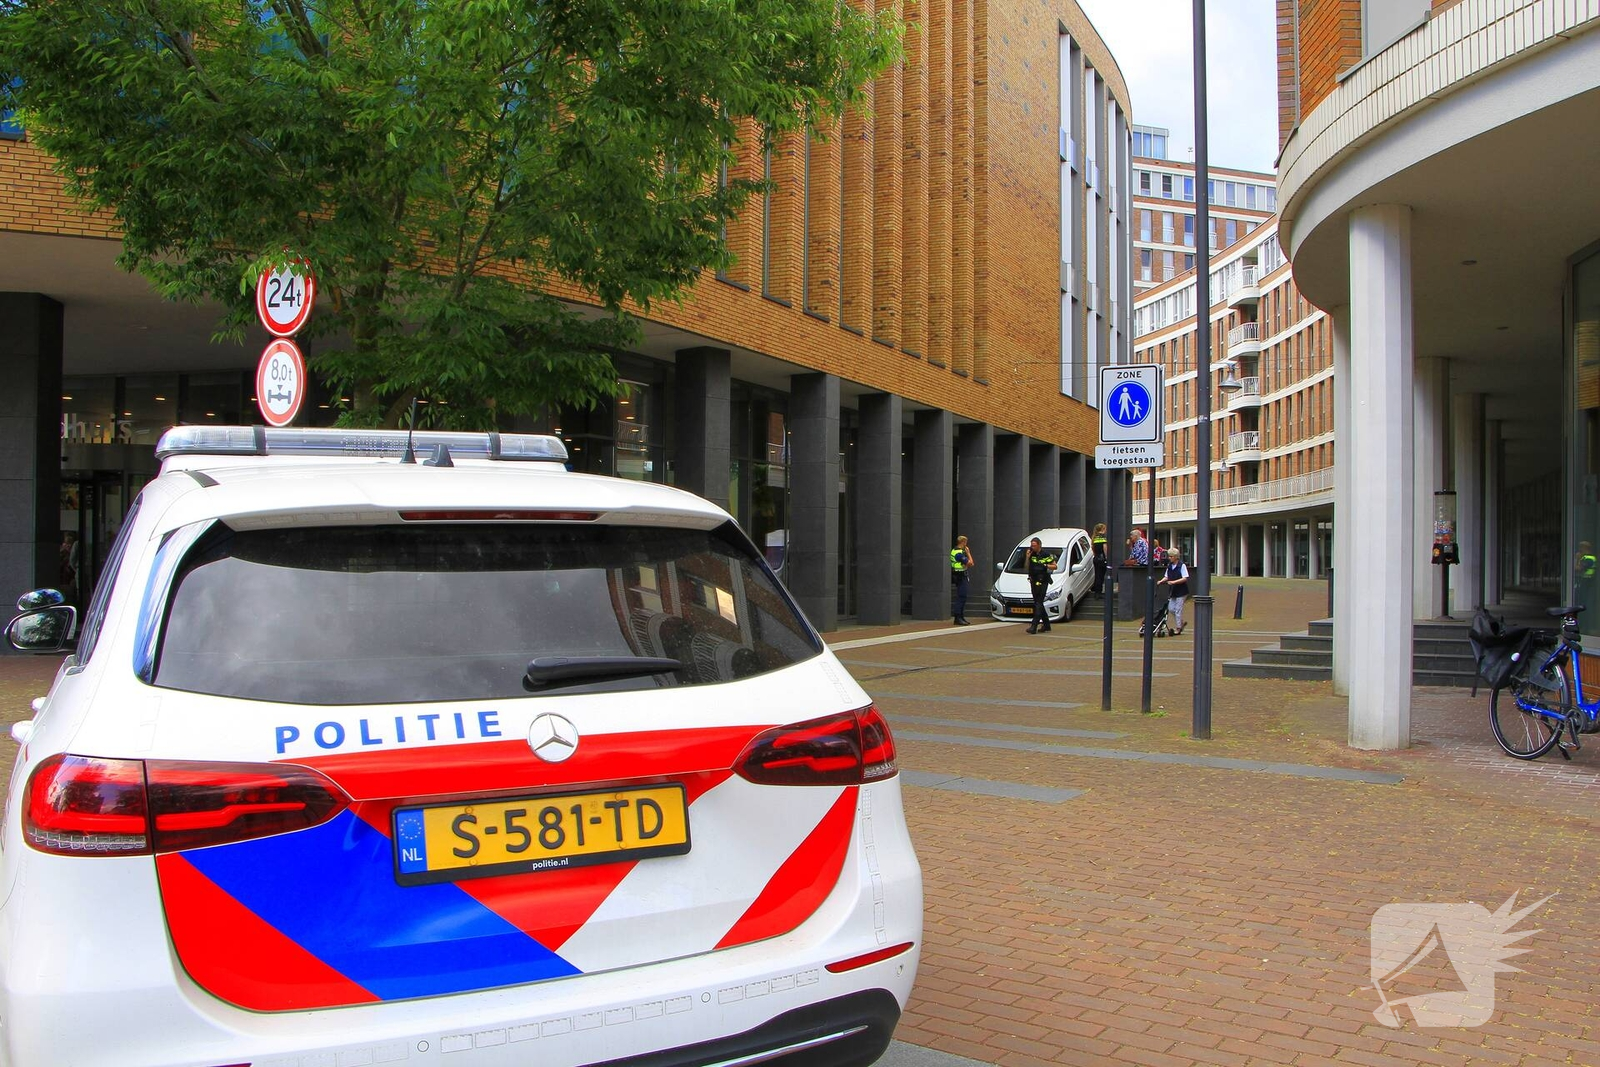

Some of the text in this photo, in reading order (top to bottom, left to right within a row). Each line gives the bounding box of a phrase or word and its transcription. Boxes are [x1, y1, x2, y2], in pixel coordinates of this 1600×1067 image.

[1116, 371, 1142, 379] ZONE
[1112, 446, 1145, 454] fietsen
[1103, 456, 1155, 466] toegestaan
[275, 711, 503, 754] POLITIE
[451, 798, 664, 858] S-581-TD
[402, 848, 422, 862] NL
[532, 857, 570, 871] politie.nl
